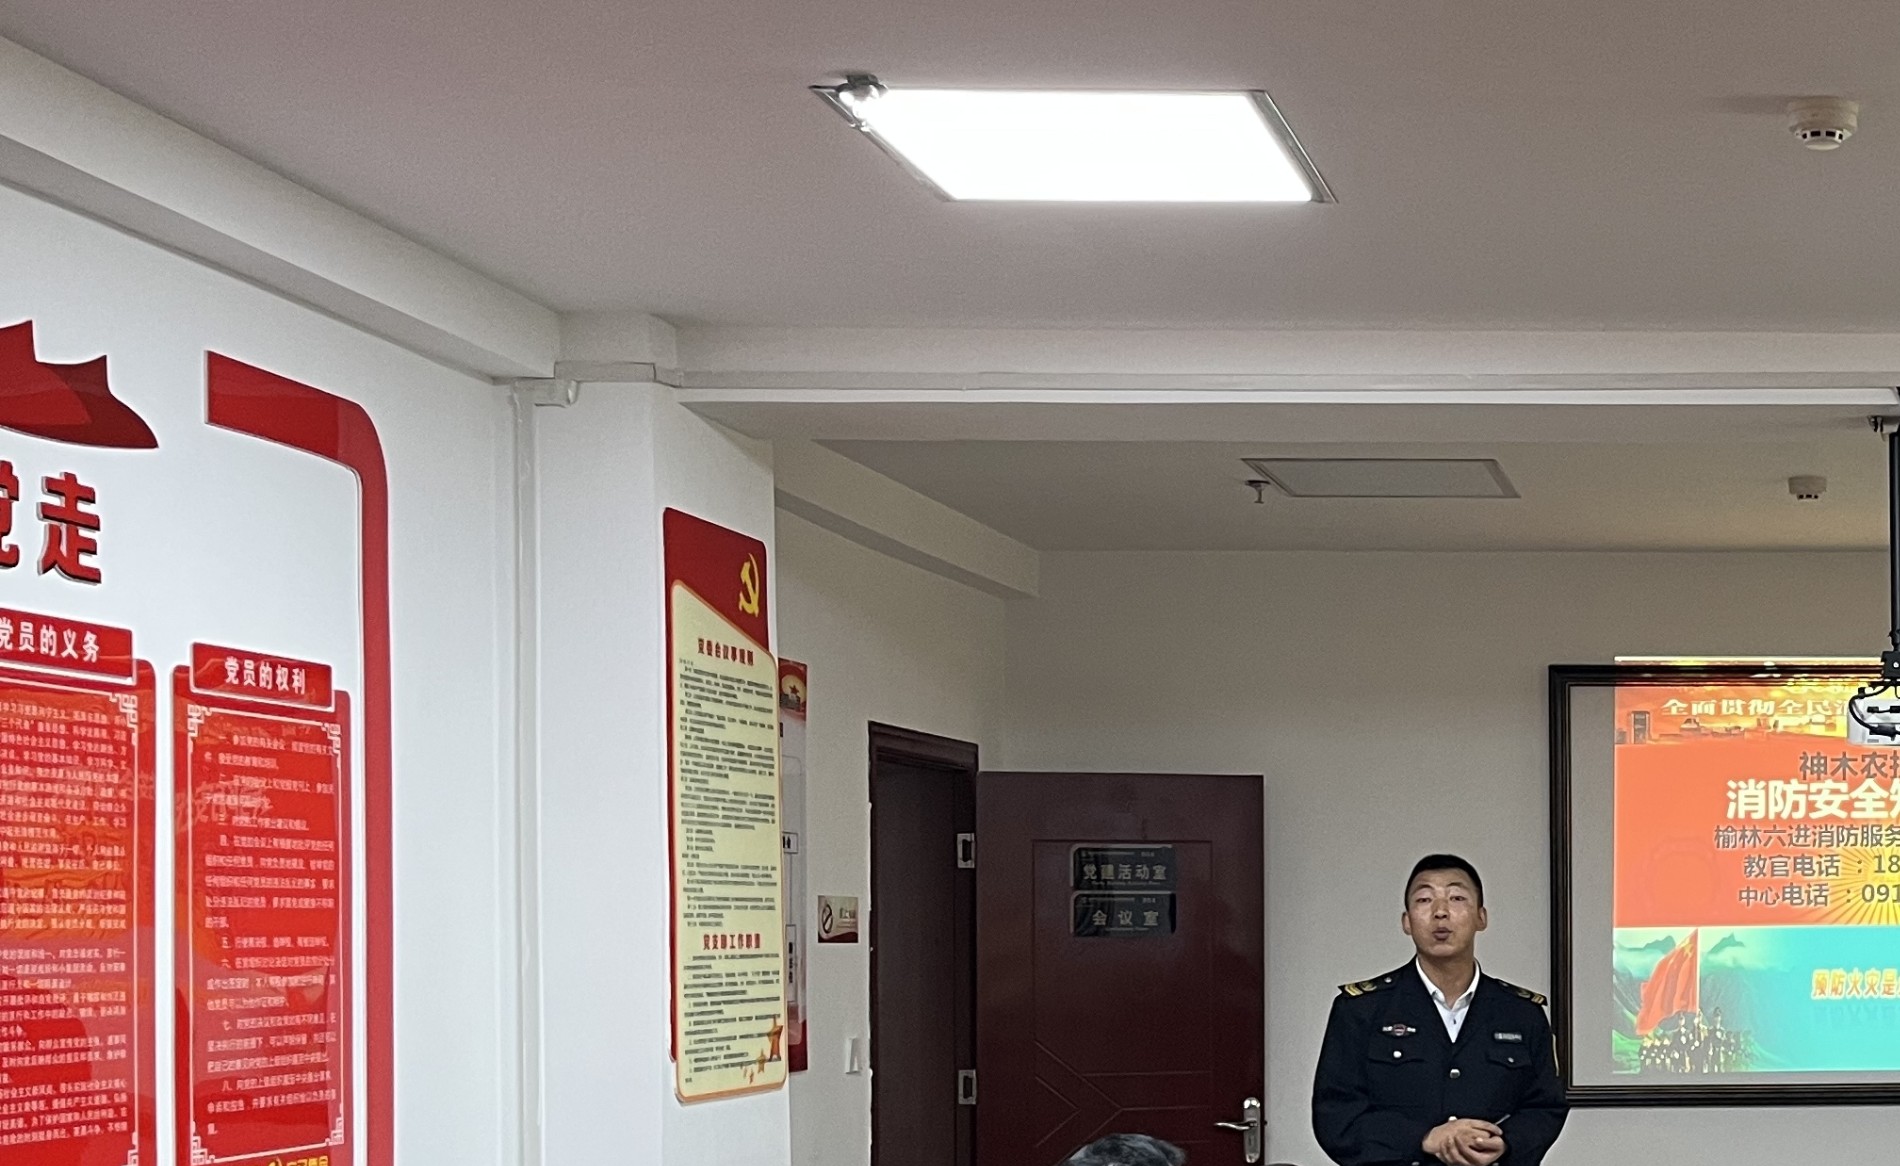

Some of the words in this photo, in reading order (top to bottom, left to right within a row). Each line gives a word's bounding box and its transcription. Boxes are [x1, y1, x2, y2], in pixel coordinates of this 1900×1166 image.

[0, 617, 99, 662] 党员的义务
[225, 656, 306, 695] 党员的权利
[1083, 863, 1167, 880] 党建活动室
[1092, 910, 1159, 926] 会议室
